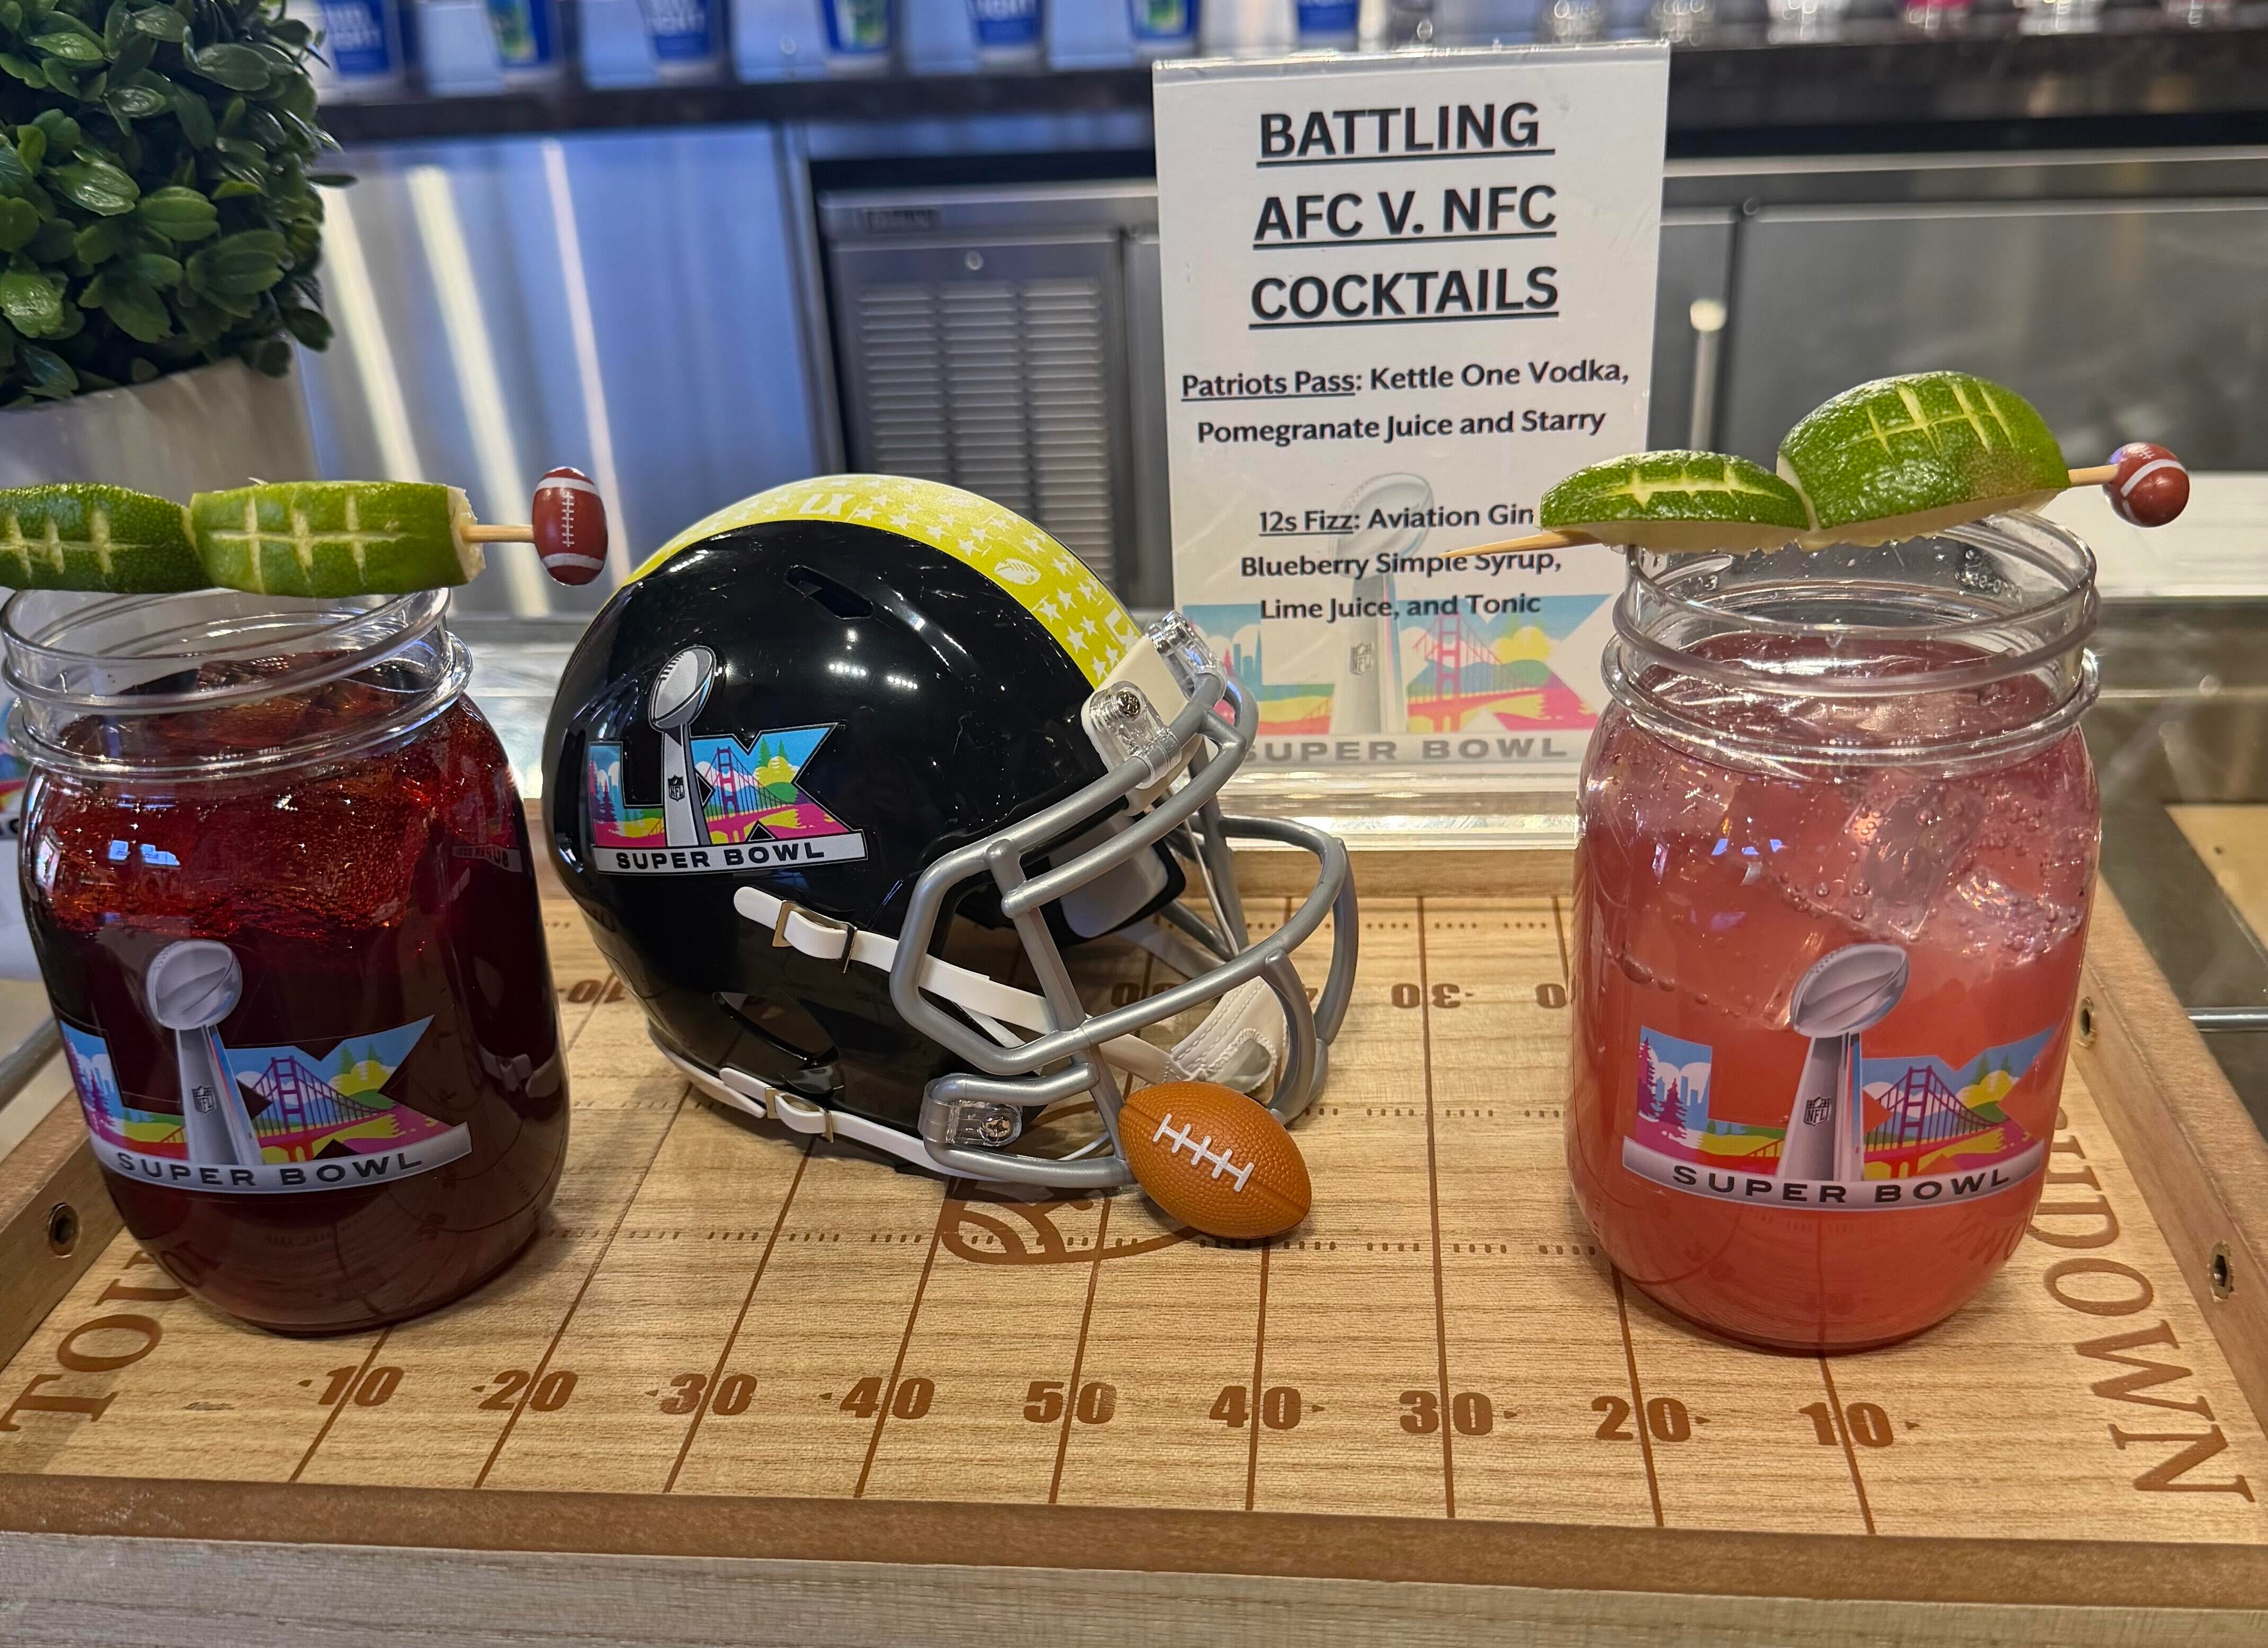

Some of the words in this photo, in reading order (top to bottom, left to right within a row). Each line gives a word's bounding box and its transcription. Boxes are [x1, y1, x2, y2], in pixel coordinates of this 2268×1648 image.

[1260, 103, 1539, 159] BATTLING
[1253, 192, 1364, 241] AFC
[1377, 190, 1424, 235] V.
[1443, 184, 1557, 233] NFC
[1251, 265, 1558, 321] COCKTAILS
[1182, 372, 1287, 398] Patriots
[1294, 369, 1364, 393] Pass:
[1370, 365, 1454, 390] Kettle
[1461, 363, 1520, 386] One
[1526, 359, 1630, 385] Vodka,
[1197, 418, 1380, 448] Pomegranate
[1384, 414, 1452, 444] Juice
[1460, 411, 1514, 435] and
[1521, 408, 1607, 436] Starry
[1259, 510, 1297, 534] 12s
[1304, 509, 1361, 532] Fizz:
[1366, 507, 1480, 530] Aviation
[1488, 503, 1534, 525] Gin
[1241, 555, 1369, 582] Blueberry
[1375, 550, 1468, 578] Simple
[1474, 553, 1561, 577] Syrup,
[1260, 597, 1323, 619] Lime
[1328, 596, 1399, 624] Juice,
[1407, 594, 1458, 617] and
[1464, 593, 1541, 615] Tonic
[1420, 737, 1567, 762] BOWL
[616, 851, 711, 870] SUPER
[725, 841, 825, 868] BOWL
[117, 1153, 257, 1188] SUPER
[280, 1152, 423, 1186] BOWL
[1673, 1165, 1847, 1204] SUPER
[1874, 1167, 2011, 1203] BOWL
[317, 1366, 405, 1407] 10
[478, 1370, 579, 1412] 20
[660, 1373, 758, 1415] 30
[840, 1377, 935, 1420] 40
[1023, 1381, 1117, 1424] 50
[1208, 1385, 1302, 1430] 40
[1399, 1390, 1493, 1436] 30
[1591, 1395, 1691, 1442] 20
[1798, 1401, 1894, 1448] 10
